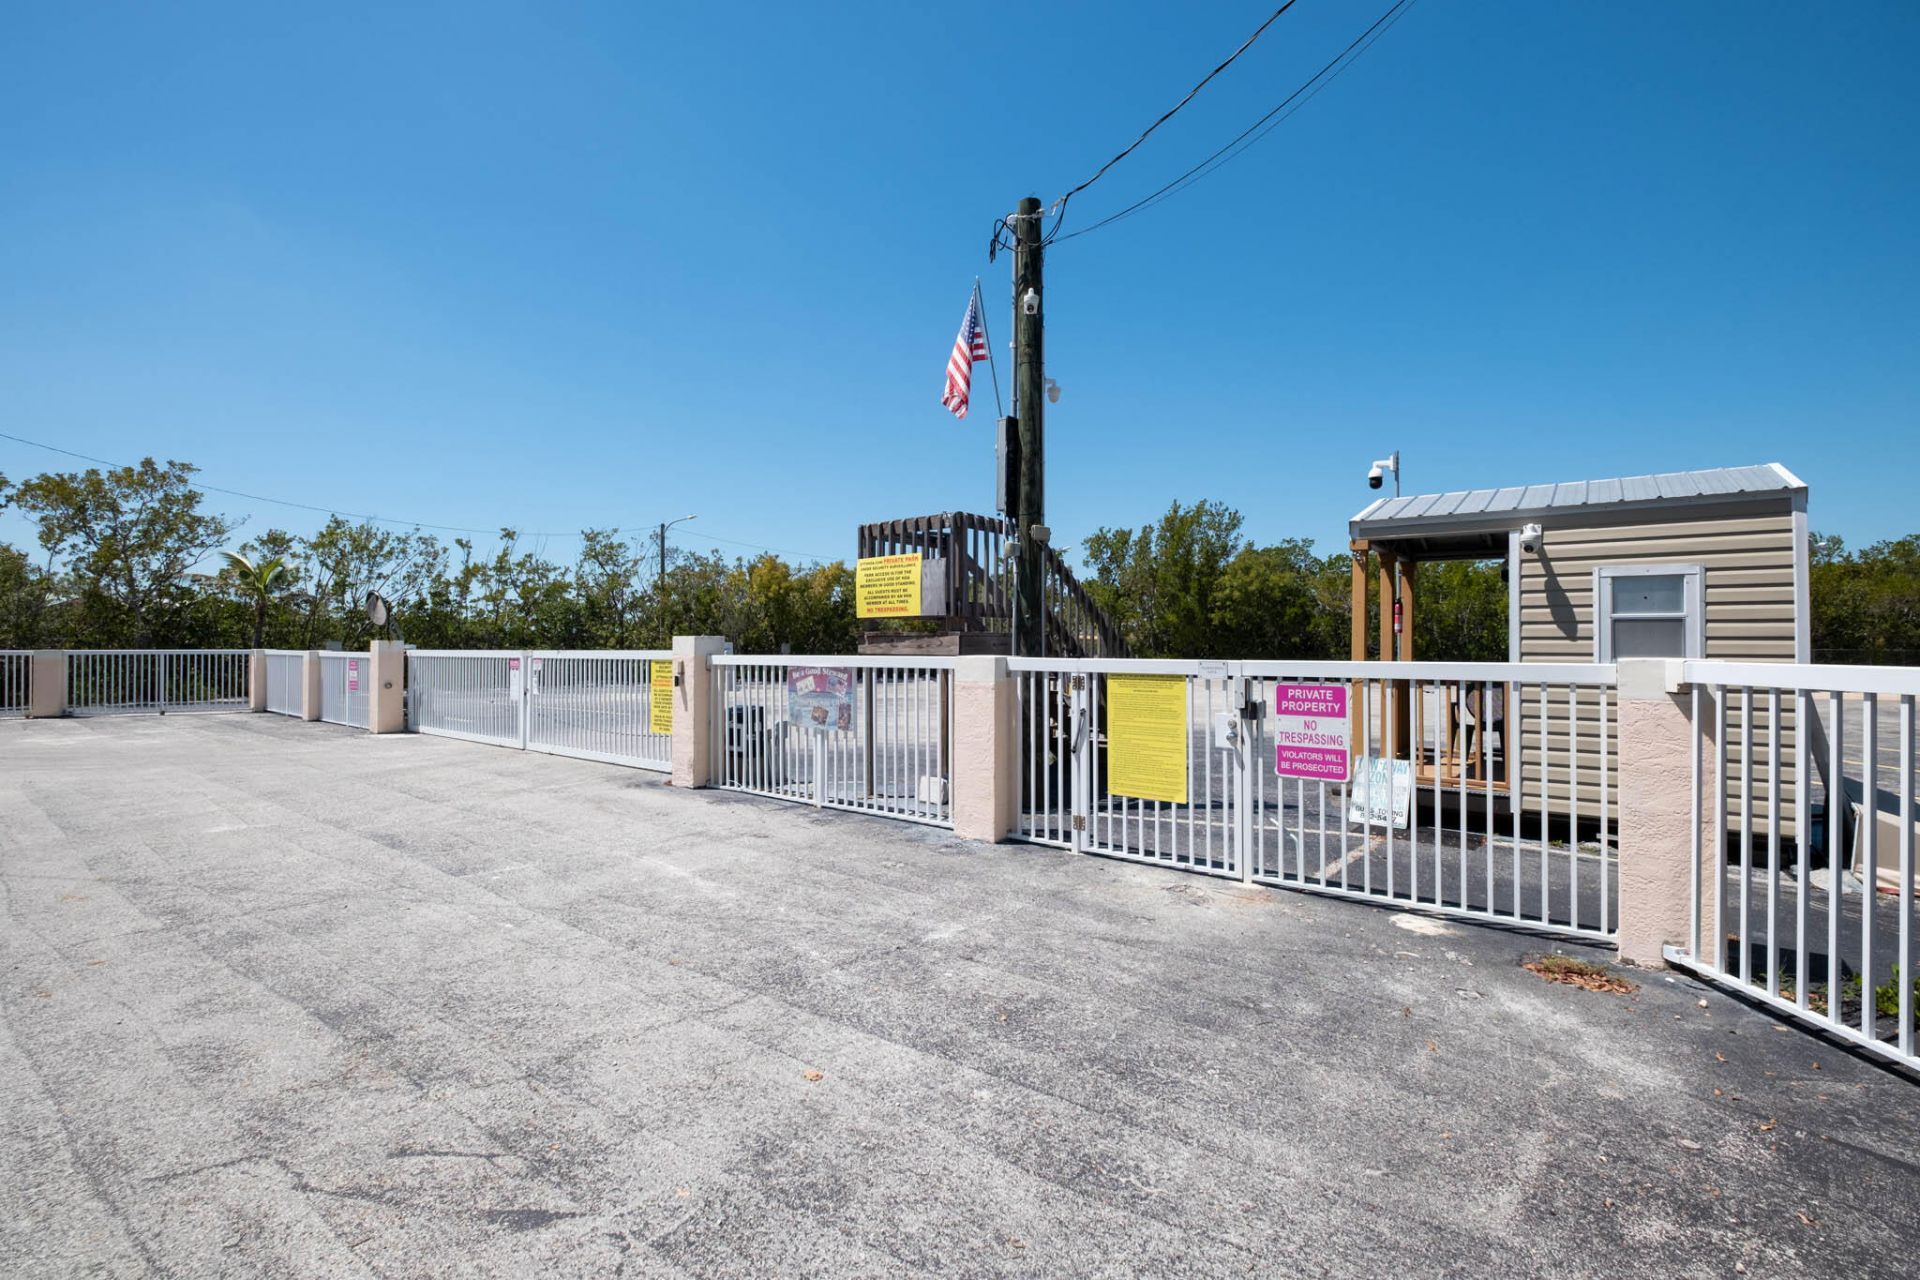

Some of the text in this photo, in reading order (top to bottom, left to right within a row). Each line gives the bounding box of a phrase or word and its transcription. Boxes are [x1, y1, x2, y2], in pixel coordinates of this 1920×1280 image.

[1288, 689, 1333, 700] PRIVATE
[1281, 701, 1340, 713] PROPERTY
[1304, 720, 1317, 731] NO
[1280, 731, 1343, 746] TRESPASSING
[1282, 750, 1342, 762] VIOLATORS WILL
[1281, 761, 1344, 774] BE PROSECUTED
[1378, 808, 1403, 817] TOING
